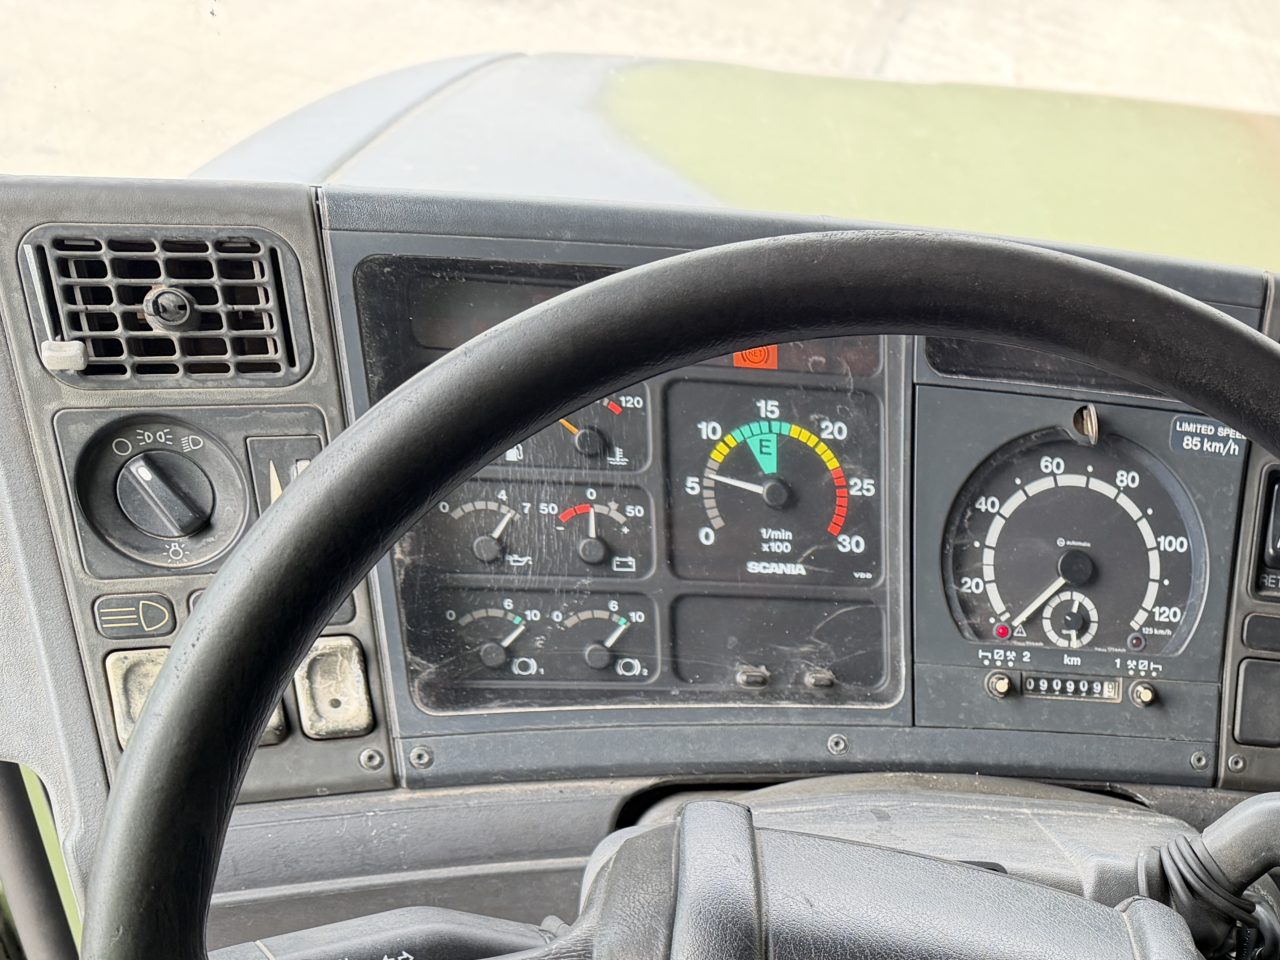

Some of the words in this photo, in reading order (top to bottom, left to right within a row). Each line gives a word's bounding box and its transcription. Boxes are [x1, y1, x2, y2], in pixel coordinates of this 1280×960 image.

[619, 396, 643, 408] 120
[757, 400, 780, 418] 15
[697, 422, 722, 439] 10
[821, 421, 847, 440] 20
[1176, 421, 1215, 435] LIMITED
[1217, 426, 1247, 439] SPEE
[759, 439, 772, 455] E
[1183, 435, 1201, 450] 85
[1203, 438, 1239, 456] km/h
[1040, 457, 1065, 474] 60
[685, 477, 700, 495] 5
[1116, 471, 1139, 488] 80
[586, 488, 597, 500] 0
[850, 479, 876, 496] 25
[497, 489, 507, 501] 4
[439, 502, 449, 513] 0
[522, 502, 531, 513] 7
[539, 503, 558, 515] 50
[975, 497, 1000, 513] 40
[625, 506, 644, 518] 50
[699, 527, 715, 545] 0
[761, 528, 792, 541] 1/min
[837, 535, 865, 553] 30
[1157, 536, 1188, 552] 100
[746, 561, 807, 575] SCANIA
[961, 577, 984, 594] 20
[503, 599, 514, 610] 6
[608, 600, 619, 611] 6
[446, 610, 456, 621] 0
[525, 610, 541, 621] 10
[552, 611, 563, 622] 0
[629, 612, 645, 623] 10
[1153, 606, 1181, 622] 120
[1022, 651, 1031, 662] 2
[1063, 654, 1081, 665] km
[1115, 658, 1121, 668] 1
